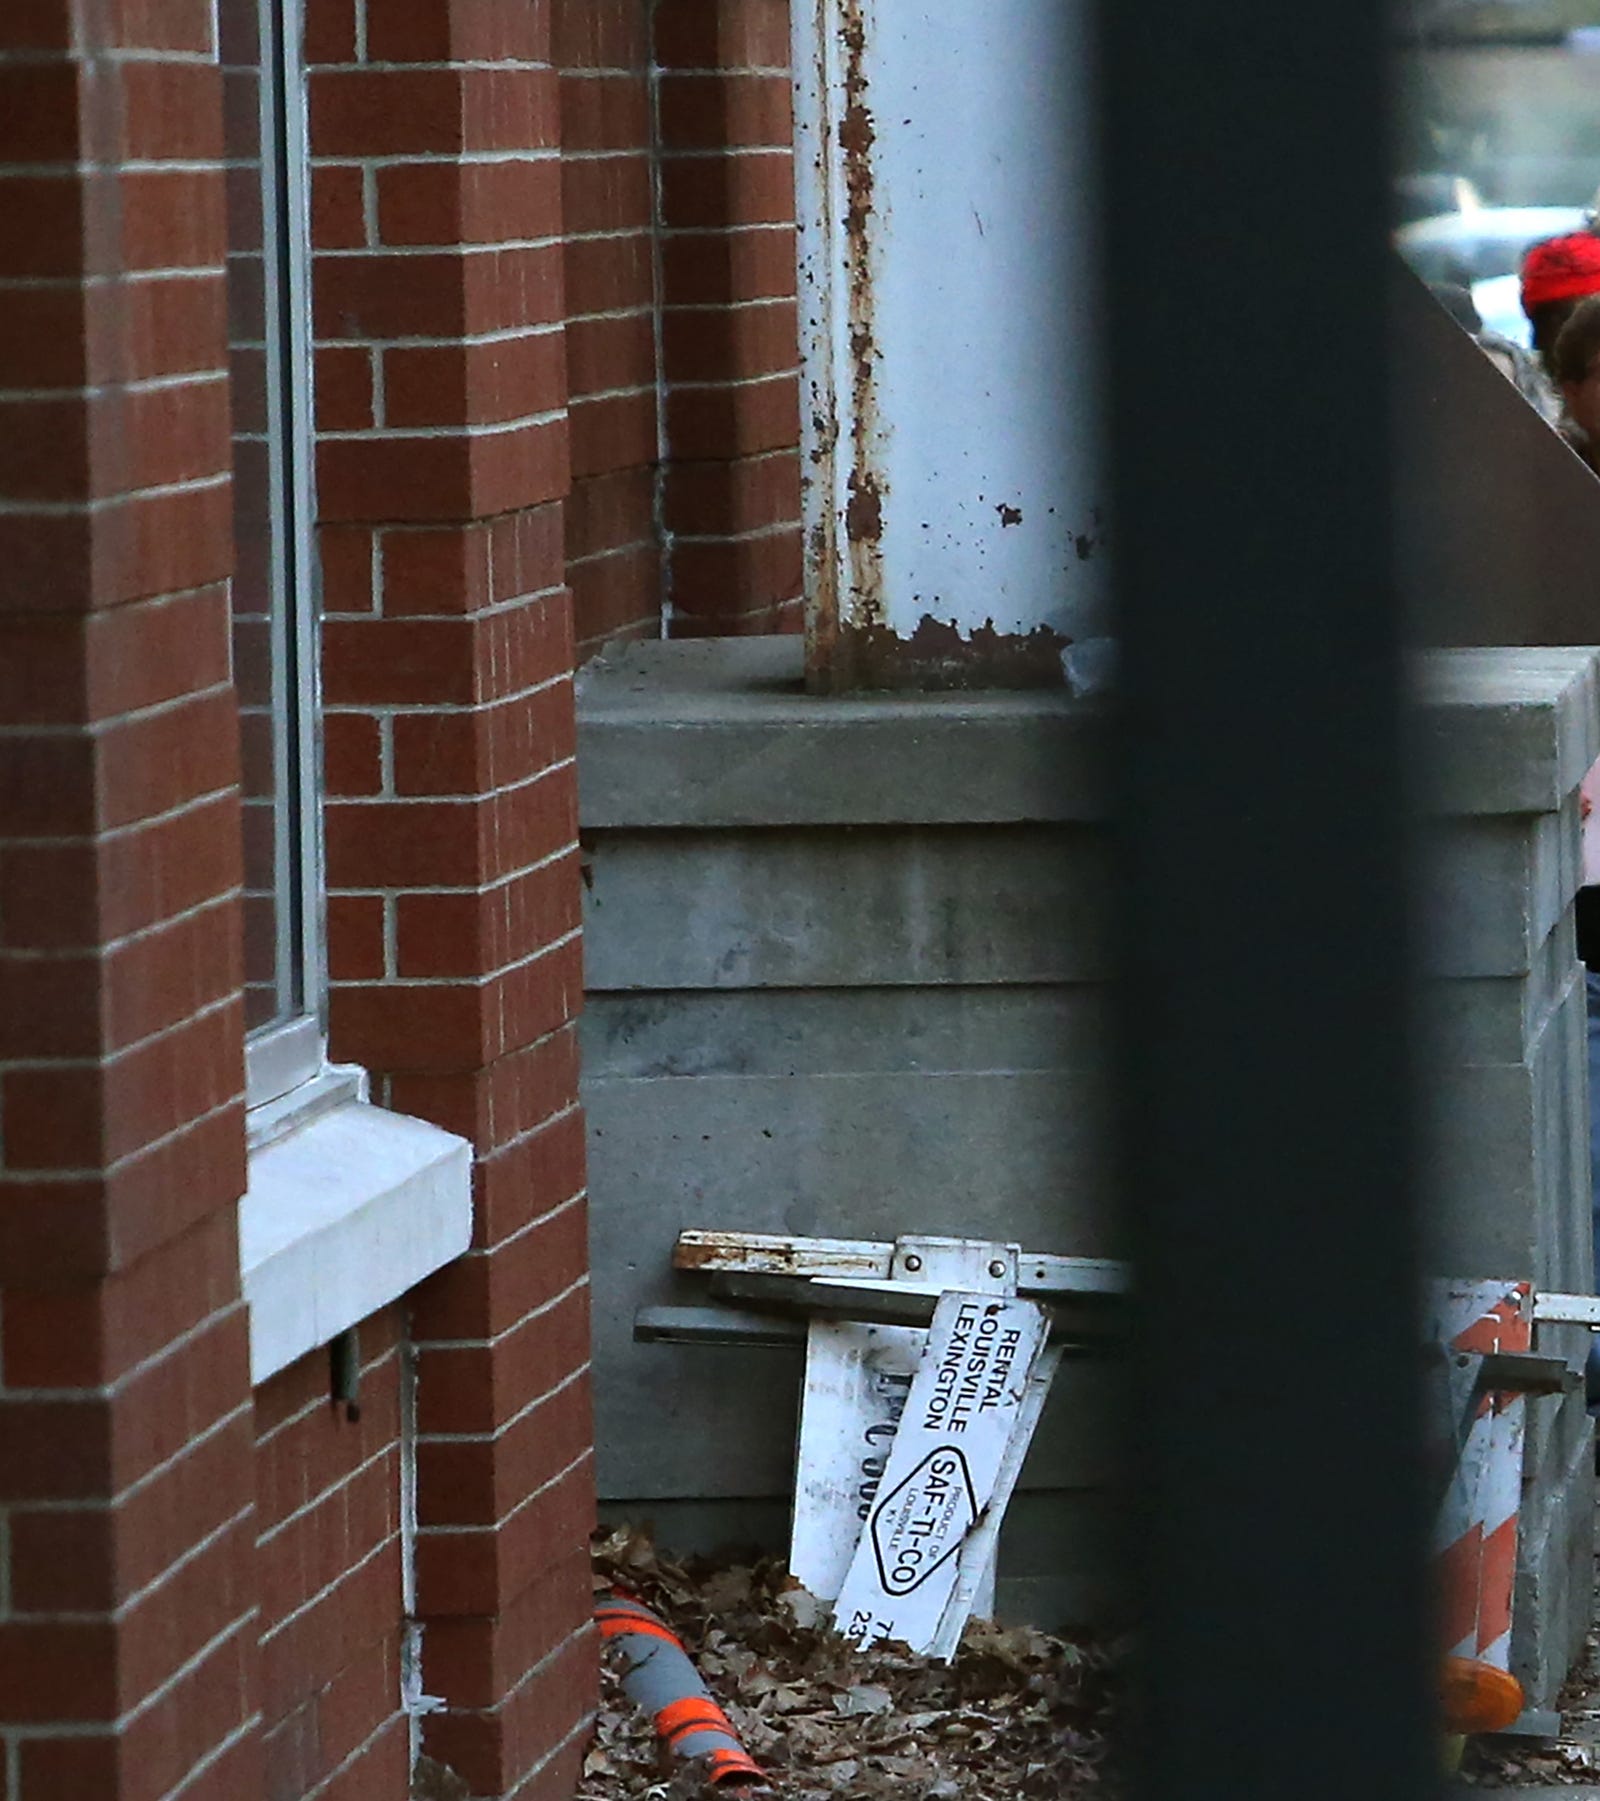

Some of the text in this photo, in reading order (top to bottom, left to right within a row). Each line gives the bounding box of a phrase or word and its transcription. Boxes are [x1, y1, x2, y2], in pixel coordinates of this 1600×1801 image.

[923, 1303, 979, 1430] LEXINGTON
[978, 1328, 1022, 1413] RENTAL
[885, 1508, 897, 1524] KY
[888, 1487, 919, 1550] LOUISVILLE
[891, 1458, 956, 1583] SAF-TI-CO
[929, 1485, 963, 1560] PRODUCT OF
